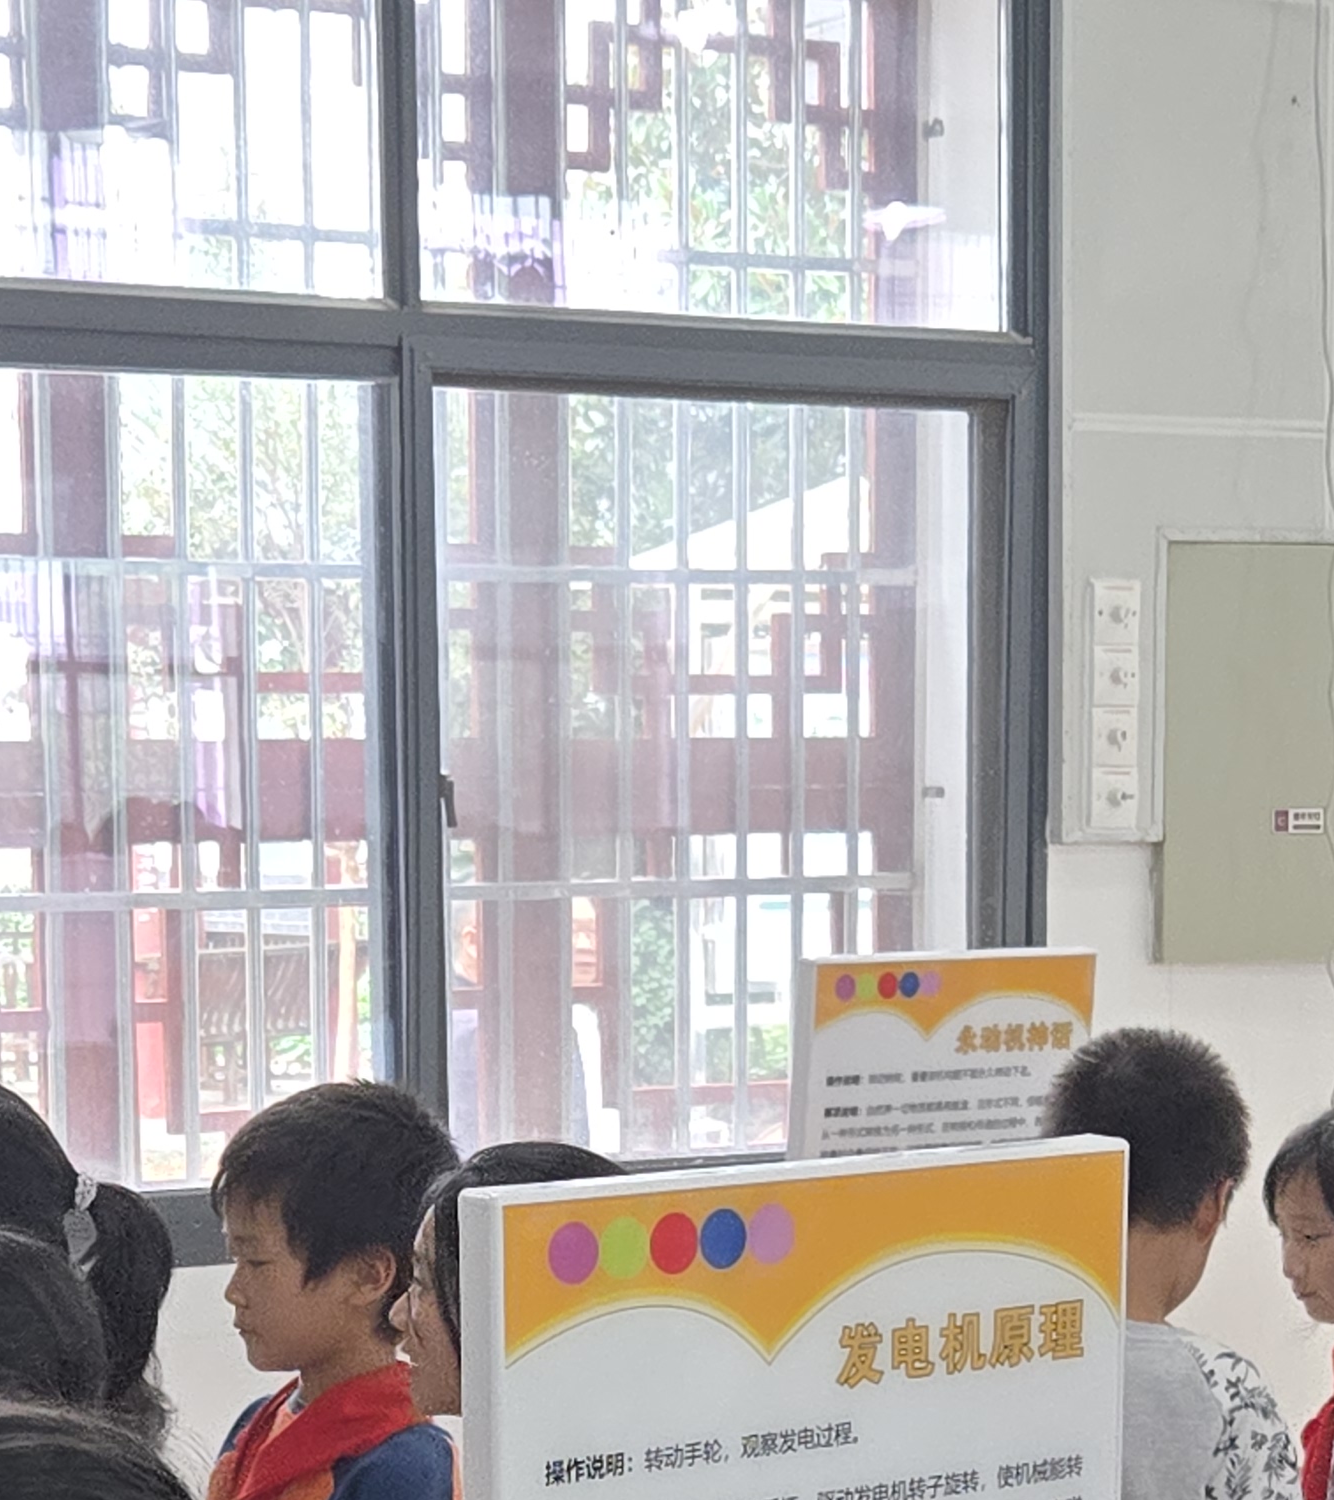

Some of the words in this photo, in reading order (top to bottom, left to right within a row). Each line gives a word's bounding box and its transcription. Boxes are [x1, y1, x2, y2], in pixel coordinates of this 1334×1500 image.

[835, 1298, 1085, 1389] 发电机原理
